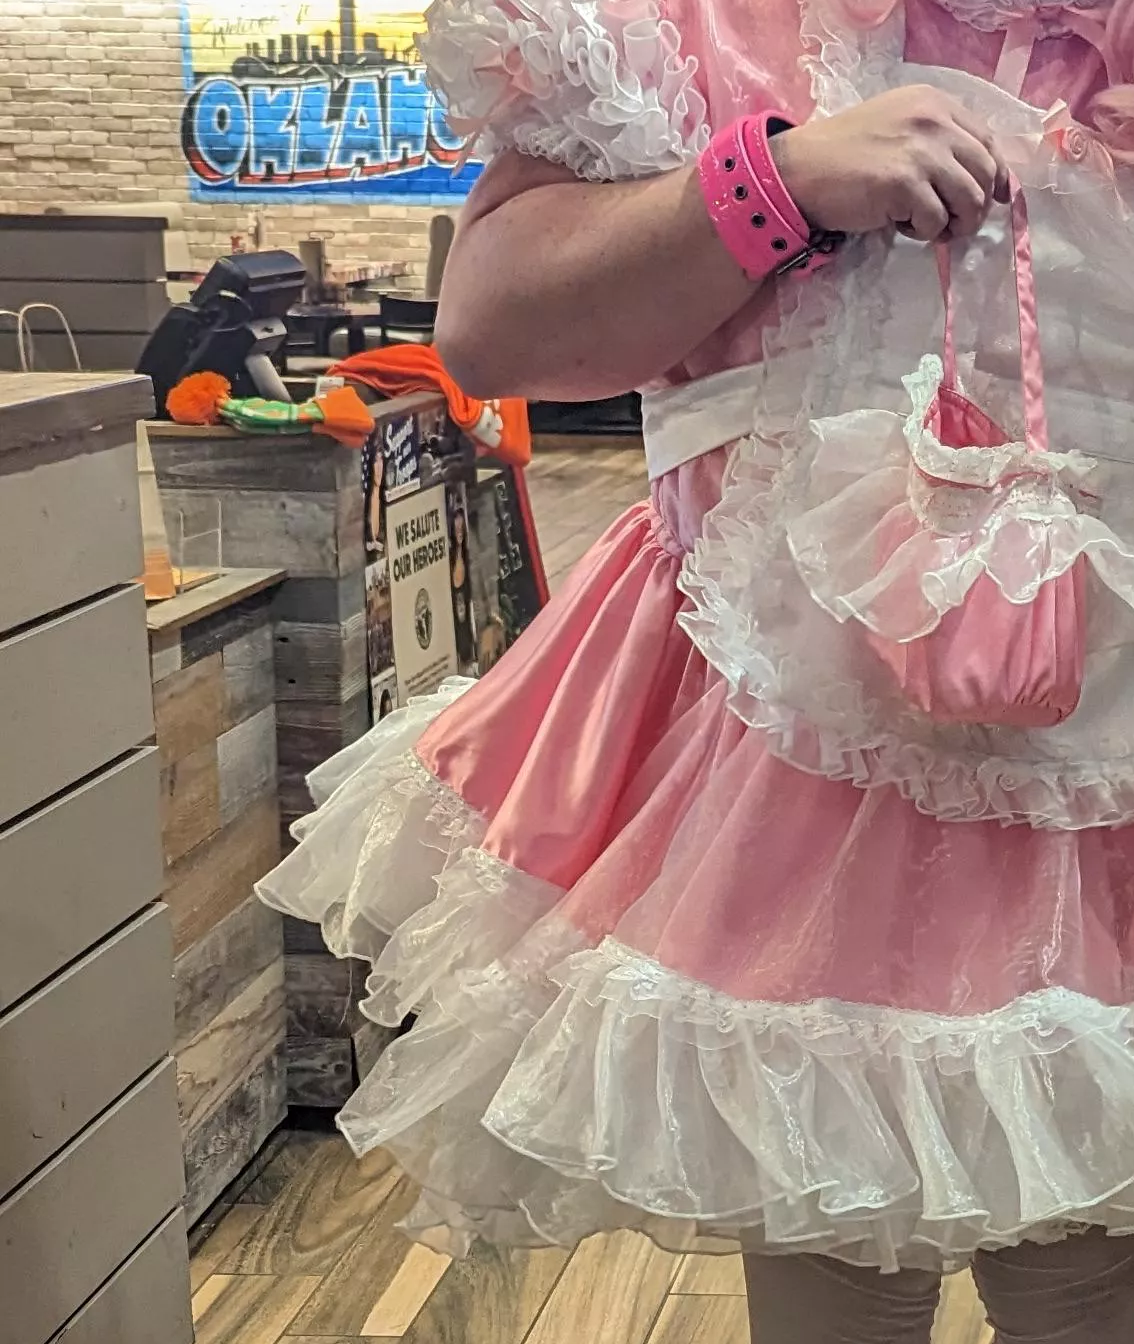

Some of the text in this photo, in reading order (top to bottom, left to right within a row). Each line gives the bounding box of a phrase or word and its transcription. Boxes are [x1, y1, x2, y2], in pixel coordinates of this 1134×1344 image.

[395, 508, 440, 550] WE SALUTE
[393, 536, 446, 582] OUR HEROES!
